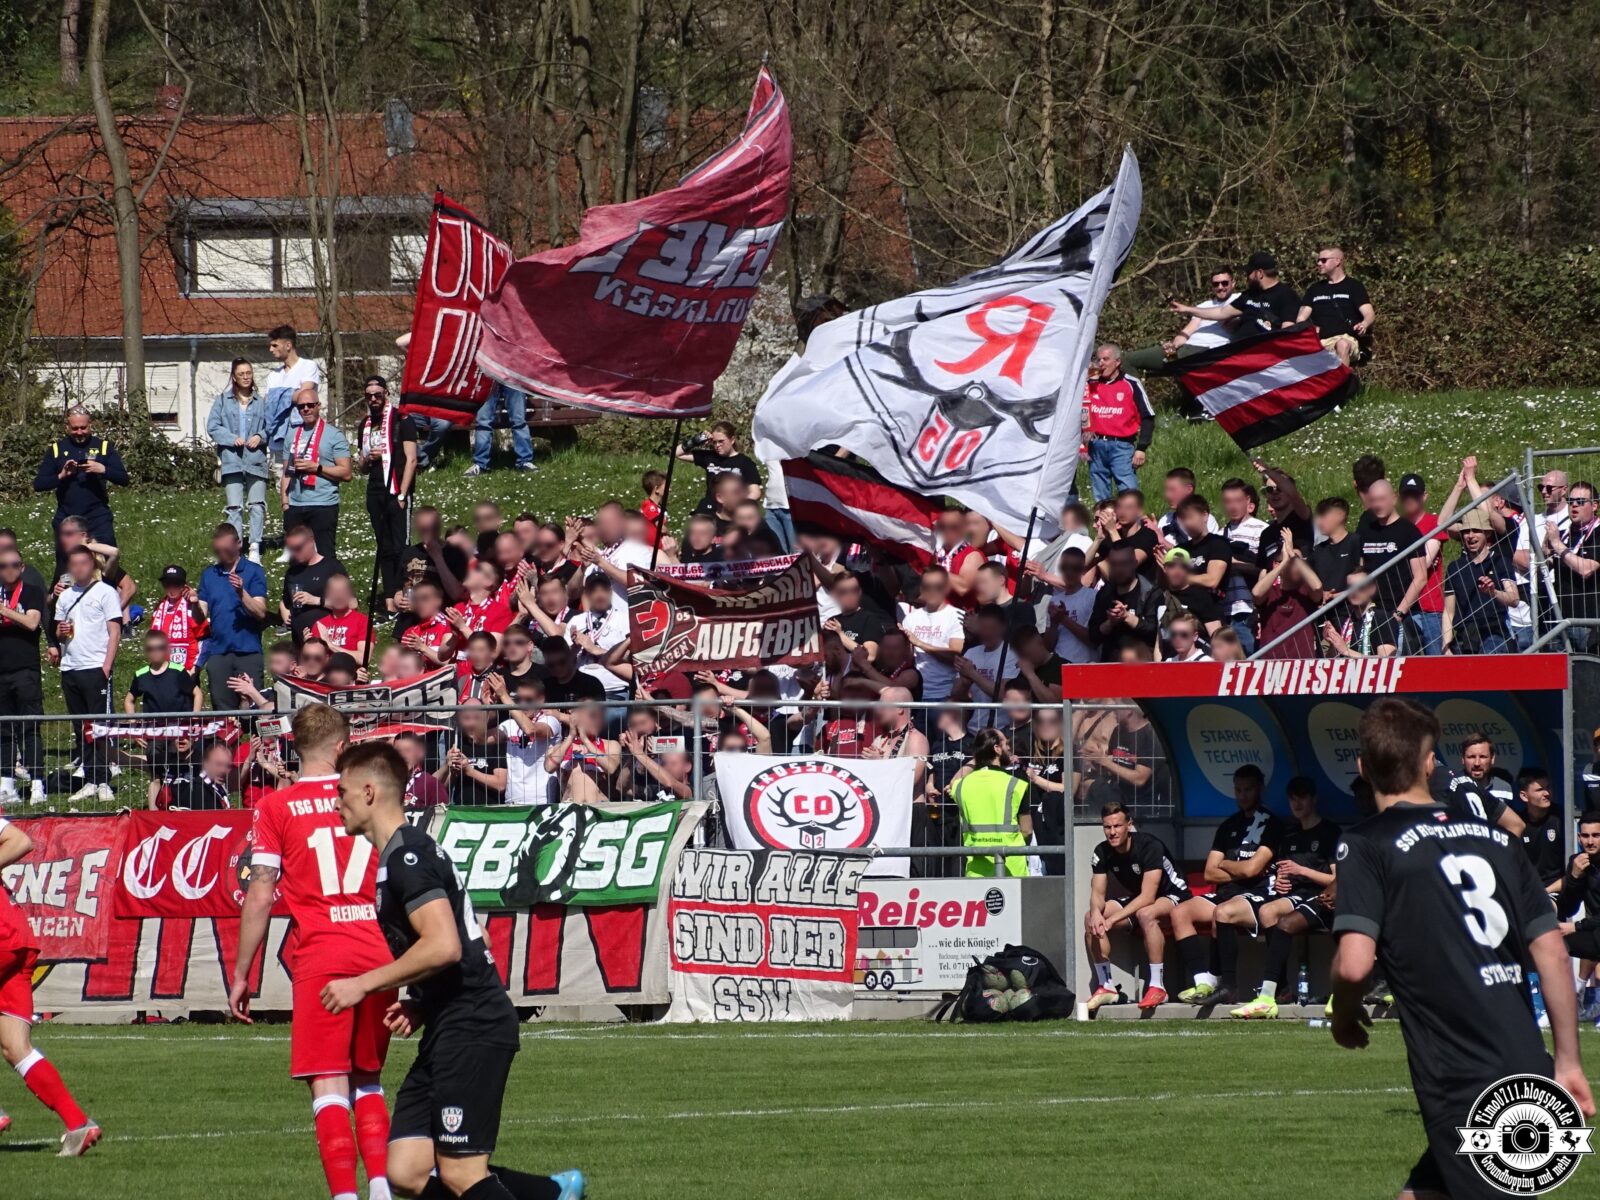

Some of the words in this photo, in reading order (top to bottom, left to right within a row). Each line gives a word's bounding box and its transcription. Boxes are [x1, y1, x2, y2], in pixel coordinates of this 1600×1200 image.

[692, 616, 820, 661] AUFGEBEN
[1217, 657, 1407, 697] ETZWIESENELF
[1200, 729, 1252, 743] STARKE
[1205, 750, 1263, 763] TECHNIK
[288, 800, 314, 816] TSG
[1396, 825, 1422, 852] SSV
[1493, 831, 1509, 847] 05
[307, 827, 373, 896] 17
[674, 850, 753, 902] WIR
[75, 849, 110, 918] E
[1440, 853, 1509, 949] 3
[859, 887, 988, 928] Reisen
[674, 911, 763, 966] SIND
[767, 915, 846, 970] DER
[953, 937, 966, 948] die
[939, 962, 951, 971] Tel.
[712, 976, 792, 1021] SSV
[438, 1134, 469, 1145] uhlsport
